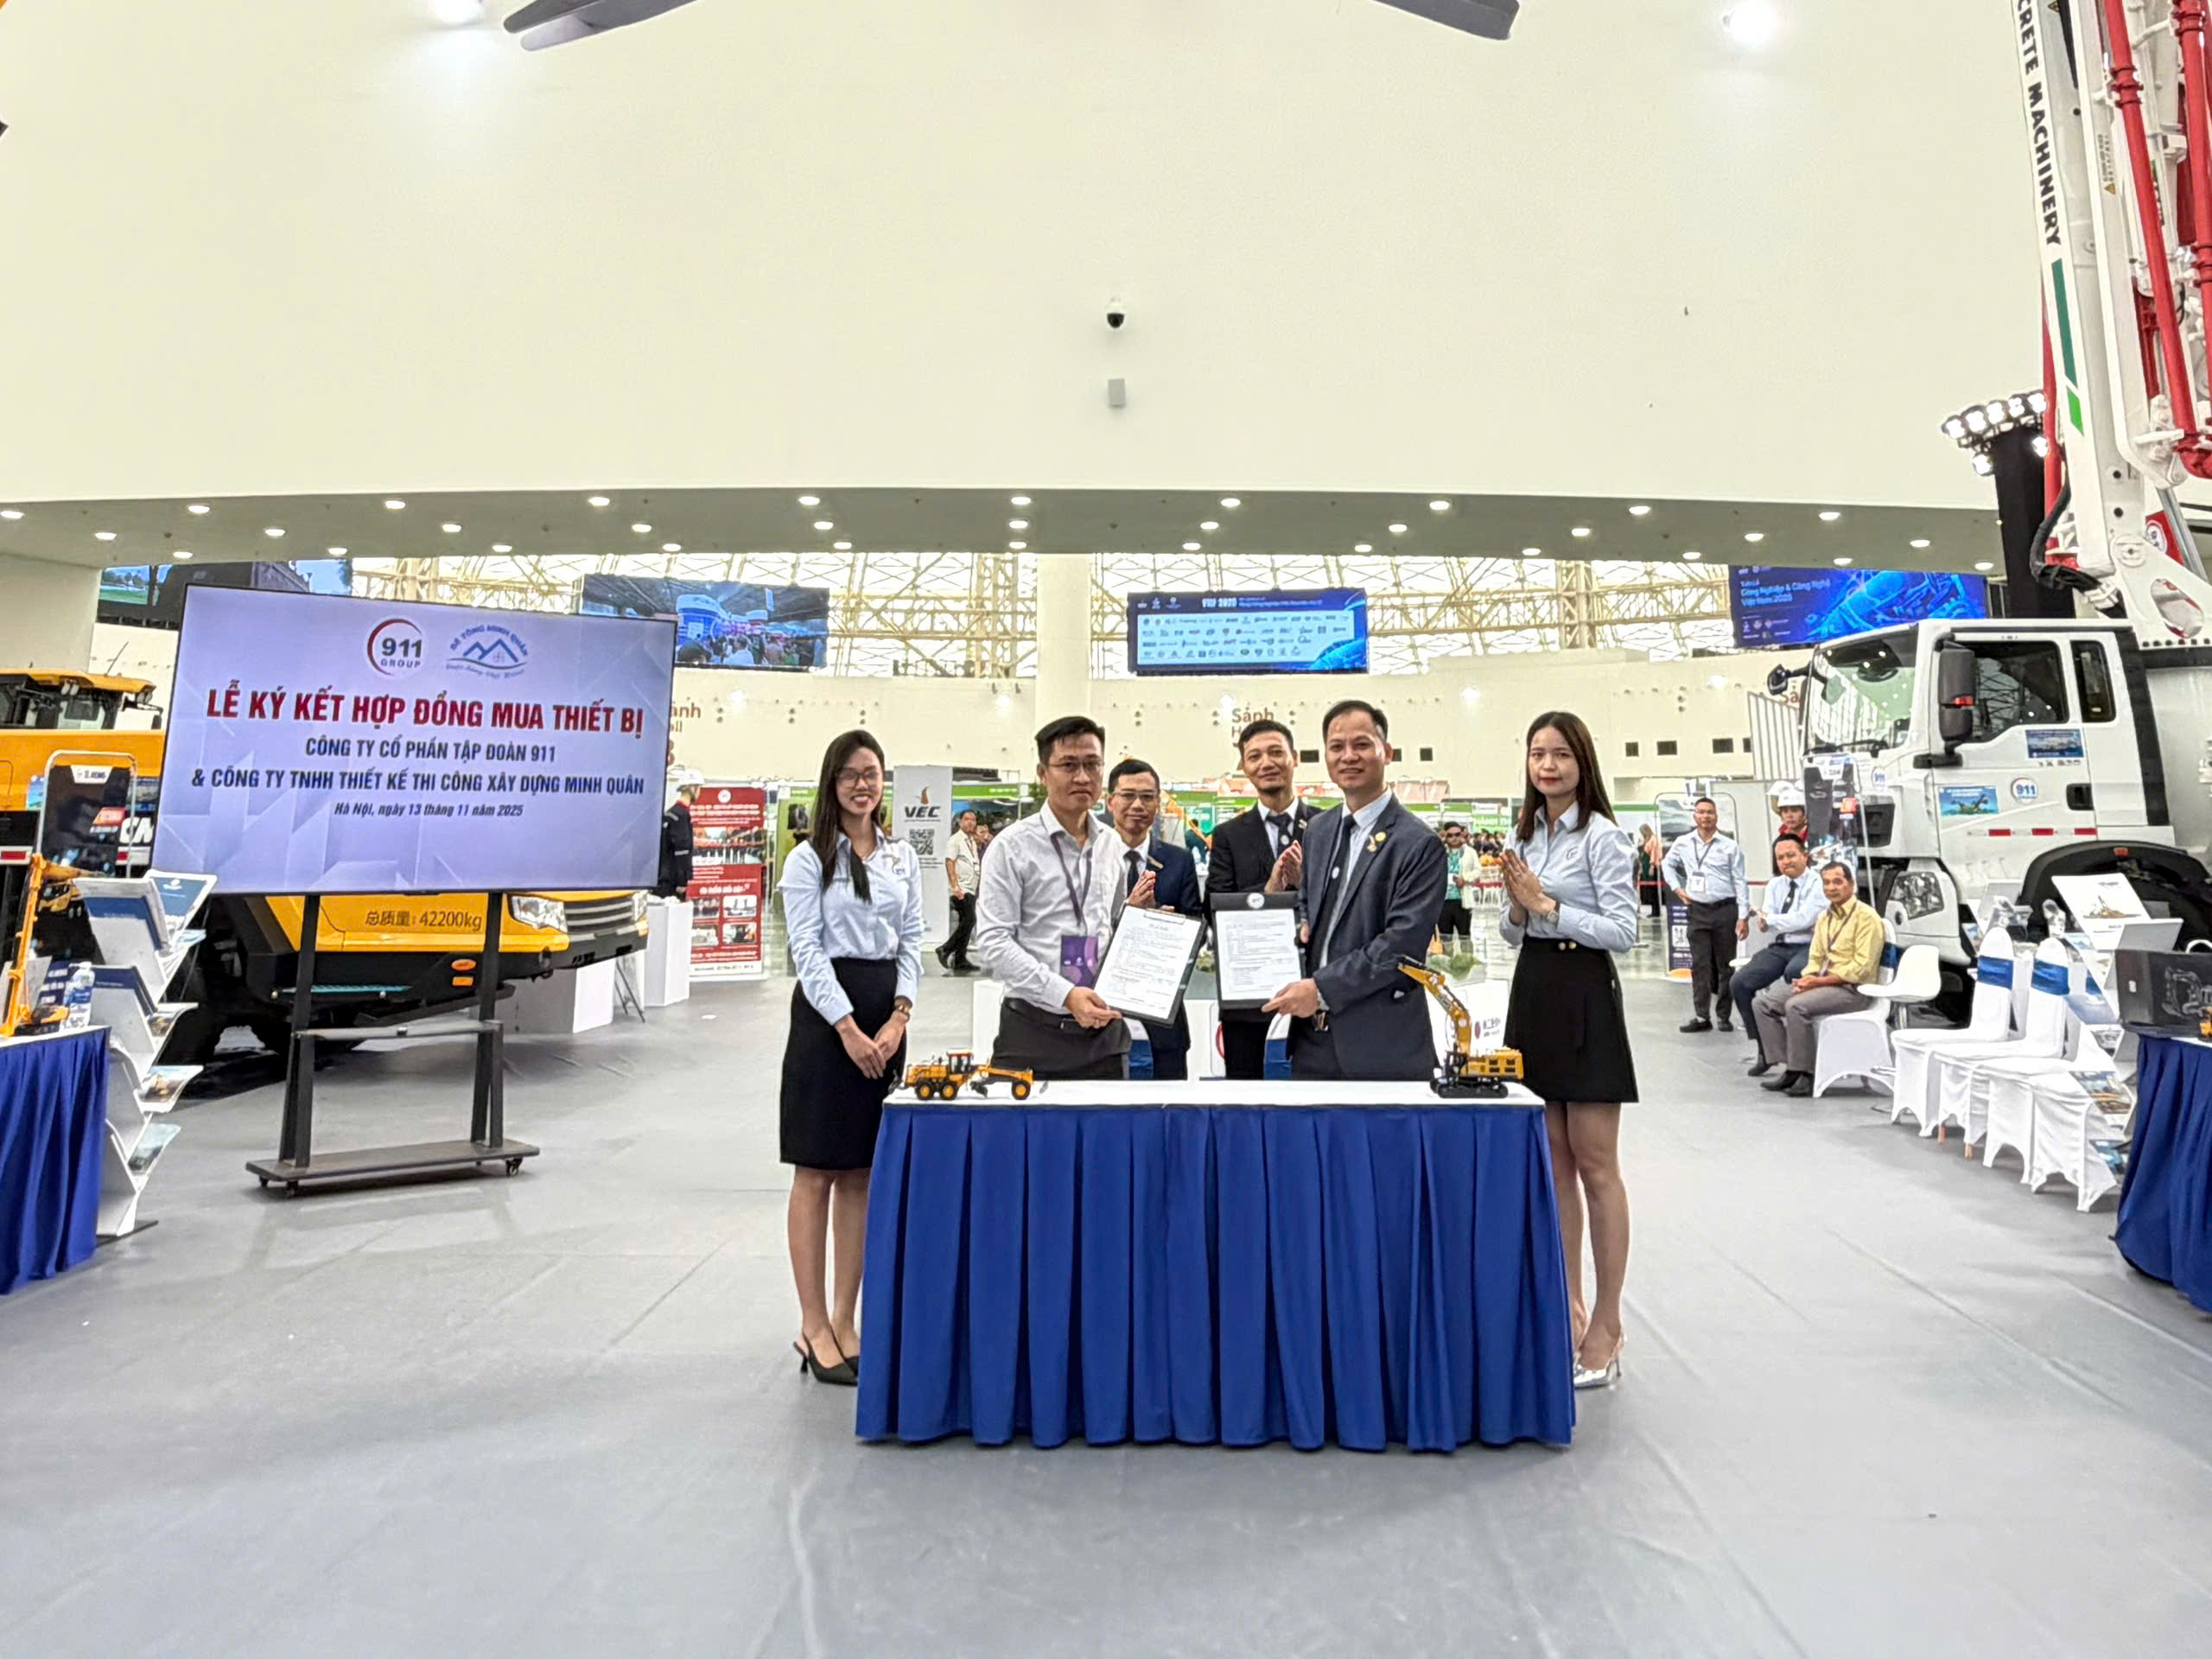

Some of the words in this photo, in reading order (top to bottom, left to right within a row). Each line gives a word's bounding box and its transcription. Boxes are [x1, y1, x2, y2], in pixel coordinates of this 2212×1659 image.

[2027, 81, 2063, 246] MACHINERY
[486, 625, 511, 637] MINH
[382, 638, 423, 658] 911
[380, 658, 421, 669] GROUP
[207, 679, 240, 718] LỄ
[248, 686, 286, 720] KÝ
[294, 685, 345, 721] KẾT
[352, 694, 406, 730] HỢP
[491, 702, 544, 729] MUA
[553, 698, 614, 733] THIẾT
[620, 708, 644, 739] BỊ
[305, 734, 351, 757] CÔNG
[357, 740, 375, 758] TY
[379, 734, 403, 759] CỔ
[454, 740, 481, 764] TẬP
[486, 741, 526, 761] ĐOÀN
[531, 745, 556, 762] 911
[192, 768, 205, 787] &
[211, 766, 259, 788] CÔNG
[265, 770, 285, 788] TY
[290, 771, 334, 789] TNHH
[339, 766, 383, 790] THIẾT
[387, 767, 410, 791] KẾ
[413, 772, 435, 791] THI
[441, 770, 482, 792] CÔNG
[487, 772, 515, 792] XÂY
[519, 774, 560, 796] DỰNG
[564, 776, 602, 794] MINH
[606, 774, 645, 796] QUÂN
[2016, 784, 2036, 796] 911
[334, 802, 350, 816] Hà
[353, 803, 374, 817] Nội,
[378, 804, 406, 817] ngày
[409, 804, 421, 816] 13
[423, 804, 454, 818] tháng
[457, 804, 469, 817] 11
[472, 804, 495, 817] năm
[497, 804, 524, 817] 2025
[904, 805, 941, 818] VEC
[420, 910, 483, 932] 42200kg
